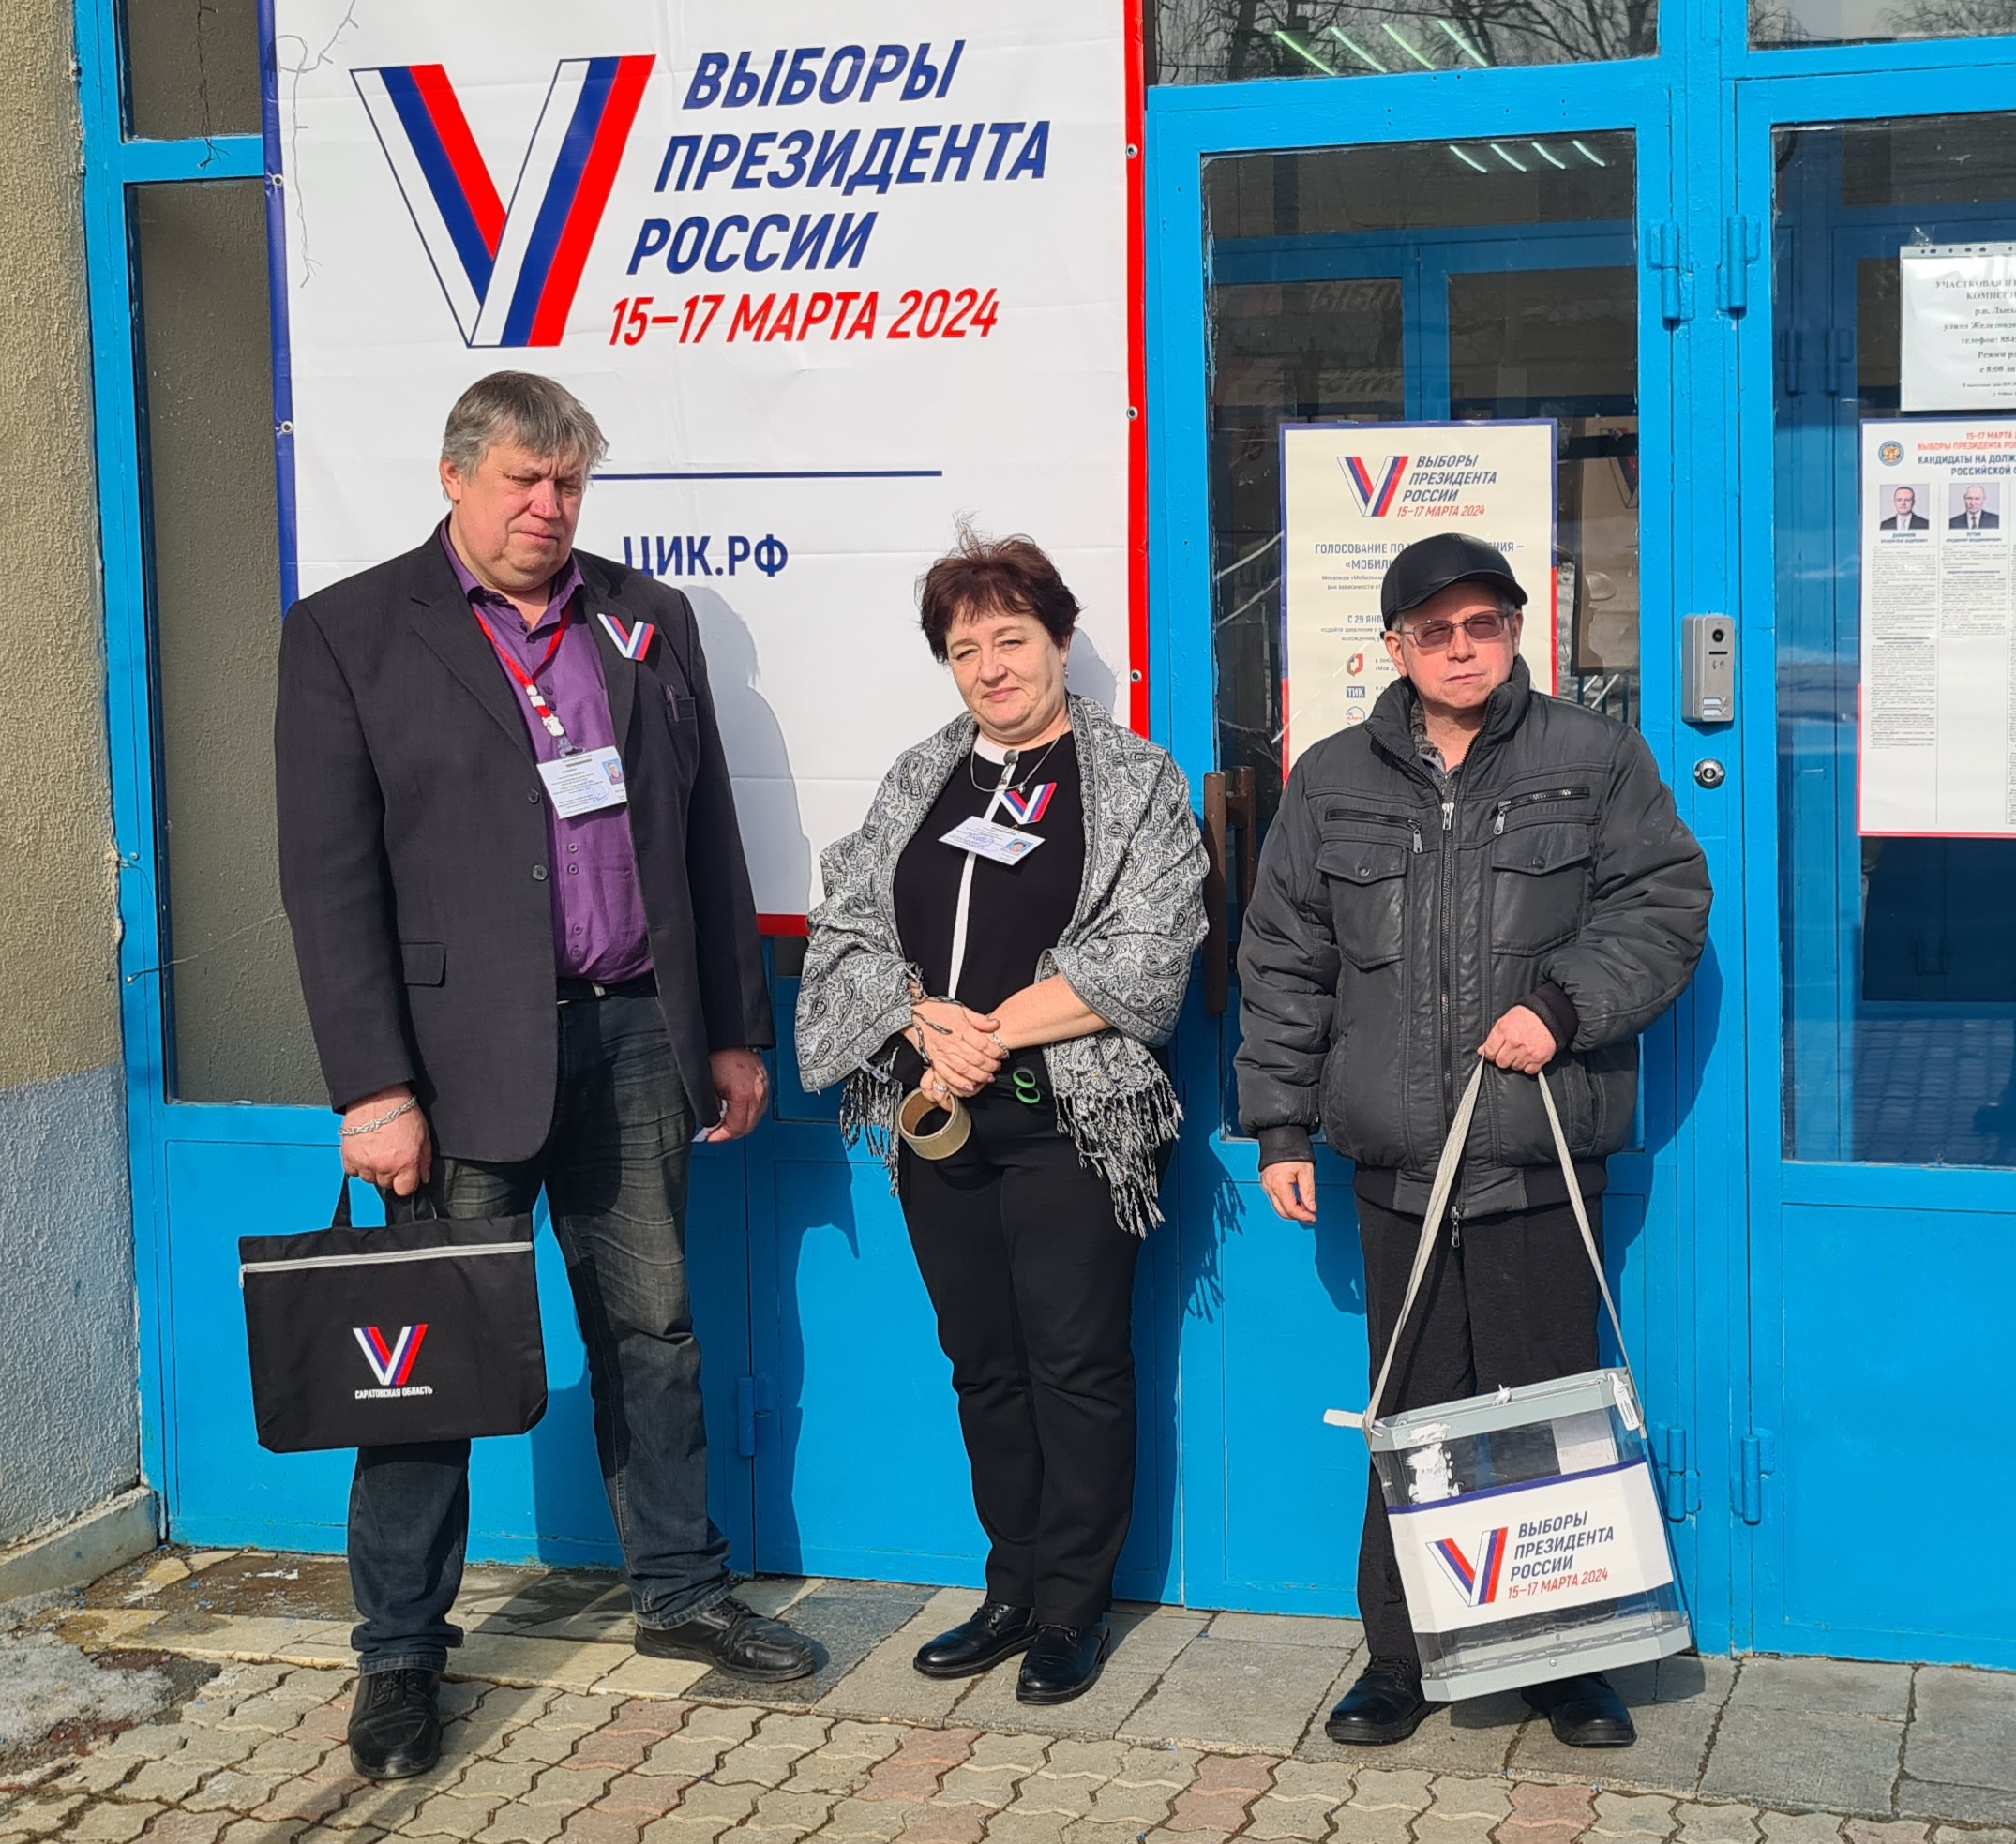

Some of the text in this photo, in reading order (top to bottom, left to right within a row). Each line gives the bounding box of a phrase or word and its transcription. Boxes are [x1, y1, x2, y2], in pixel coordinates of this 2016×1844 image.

[682, 39, 966, 110] ВЫБОРЫ
[654, 120, 1050, 196] ПРЕЗИДЕНТА
[626, 212, 878, 275] РОССИИ
[1935, 279, 2002, 289] УЧАСТКОВАЯ
[726, 291, 880, 343] МАРТА
[886, 288, 1000, 339] 2024
[1952, 442, 2002, 450] ПРЕЗИДЕНТА
[1416, 455, 1479, 469] ВЫБОРЫ
[1918, 454, 1973, 465] КАНДИДАТЫ
[1975, 454, 1987, 464] НА
[1950, 464, 2011, 476] РОССИЙСКОЙ
[1409, 471, 1497, 487] ПРЕЗИДЕНТА
[1402, 489, 1459, 502] РОССИИ
[1424, 505, 1460, 517] МАРТА
[1460, 504, 1486, 517] 2024
[1315, 543, 1387, 555] ГОЛОСОВАНИЕ
[1390, 543, 1404, 554] ПО
[623, 534, 788, 578] ЦИК.РФ
[1345, 559, 1391, 570] «МОБИЛ
[1347, 615, 1353, 623] С
[1354, 615, 1364, 623] 29
[1347, 687, 1364, 697] ТИК
[354, 1387, 433, 1399] САРАТОВСКАЯ ОБЛАСТЬ
[1517, 1510, 1588, 1539] ВЫБОРЫ
[1513, 1526, 1614, 1560] ПРЕЗИДЕНТА
[1510, 1554, 1574, 1582] РОССИИ
[1540, 1573, 1578, 1594] МАРТА
[1580, 1567, 1609, 1585] 2024
